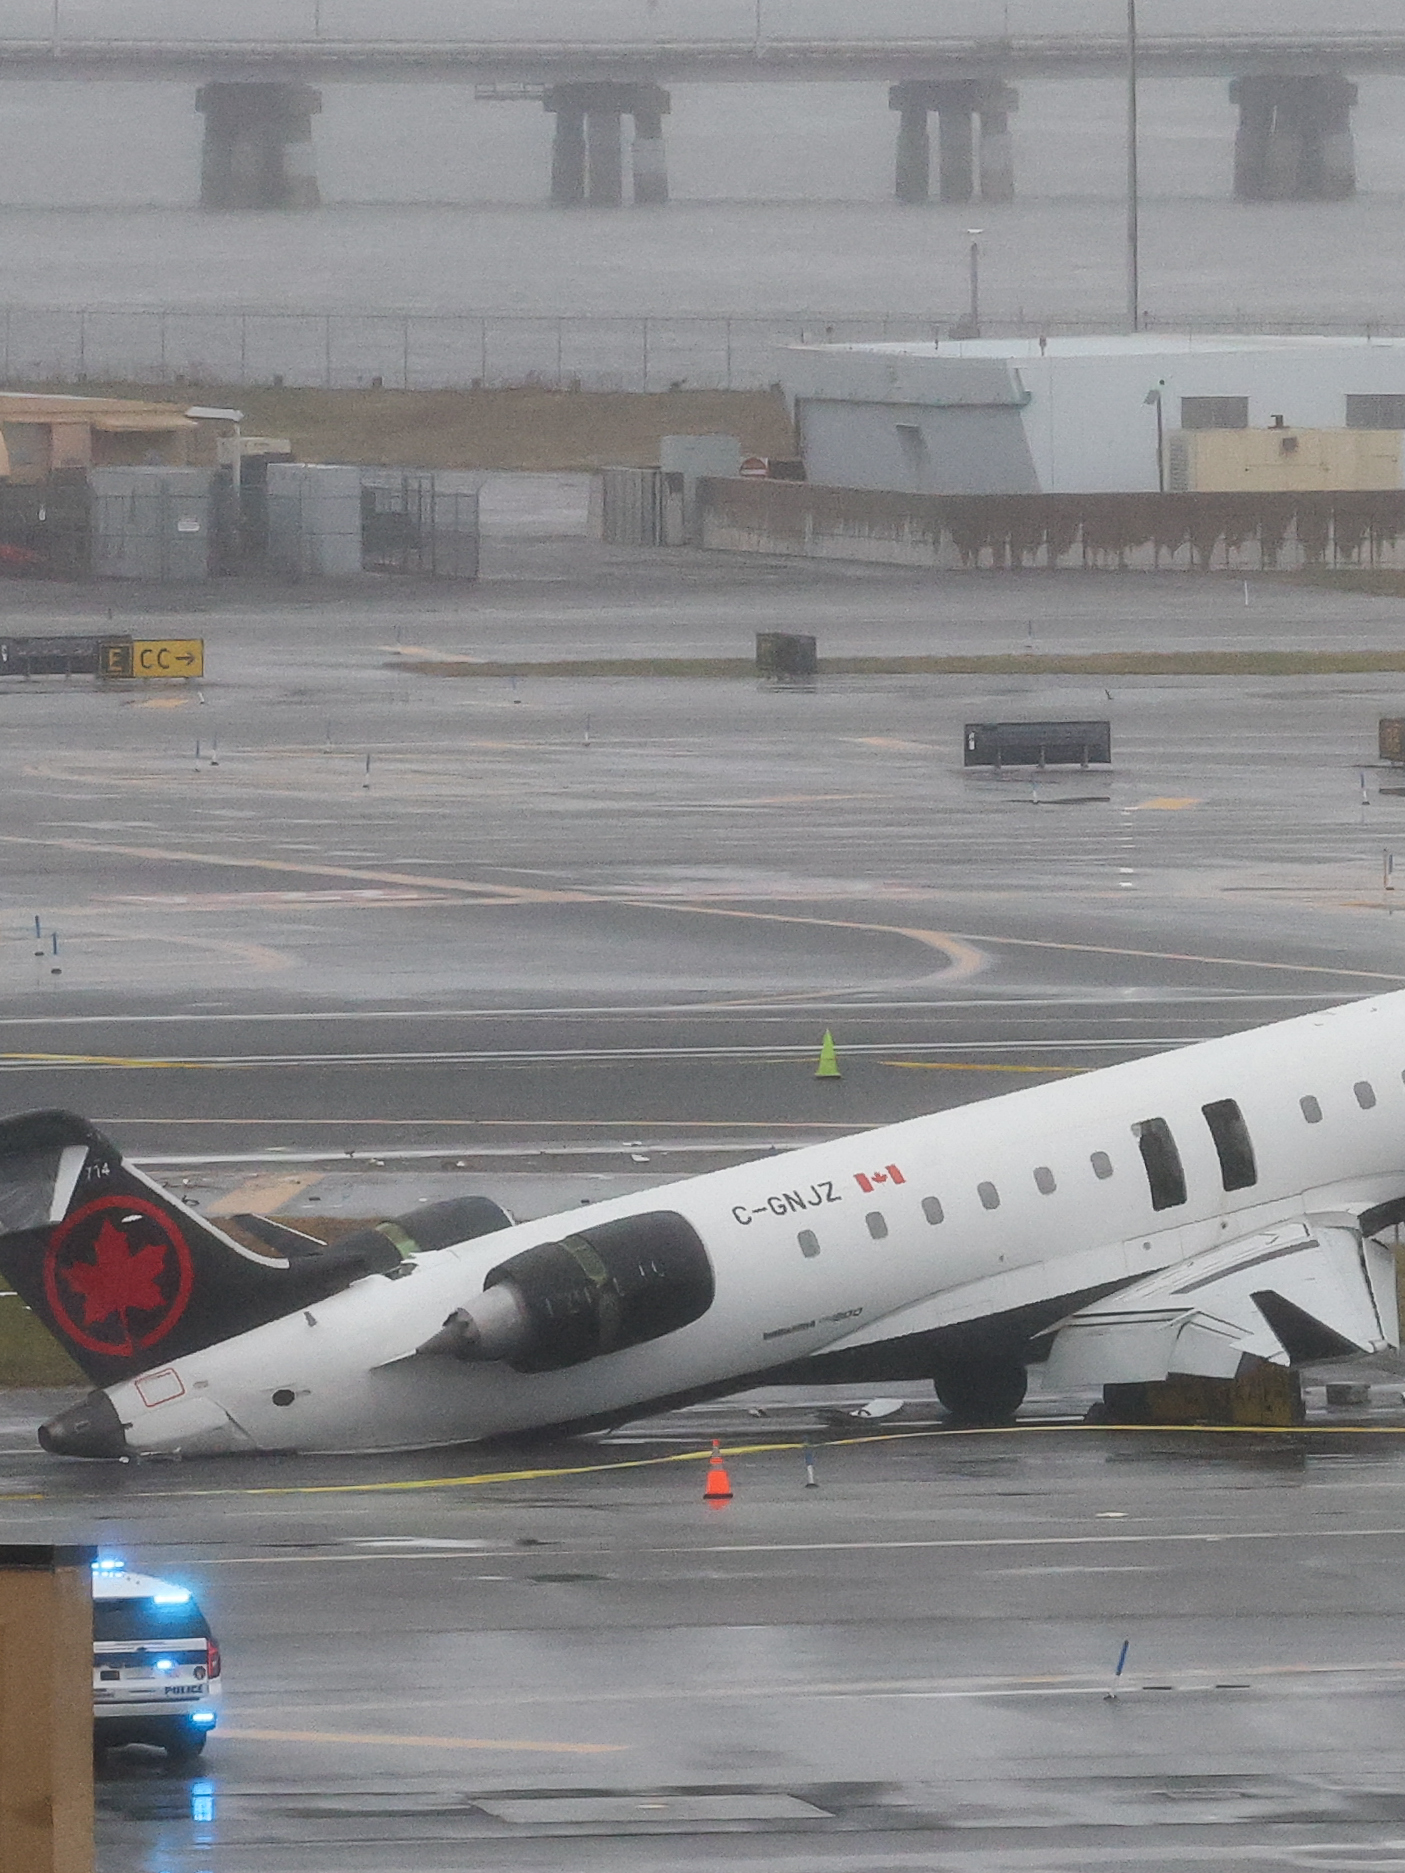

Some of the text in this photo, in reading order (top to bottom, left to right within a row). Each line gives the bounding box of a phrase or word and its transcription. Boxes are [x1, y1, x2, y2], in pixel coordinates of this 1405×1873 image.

[108, 648, 171, 671] E CC
[731, 1180, 842, 1226] C-GNJZ
[164, 1683, 203, 1695] POLICE
